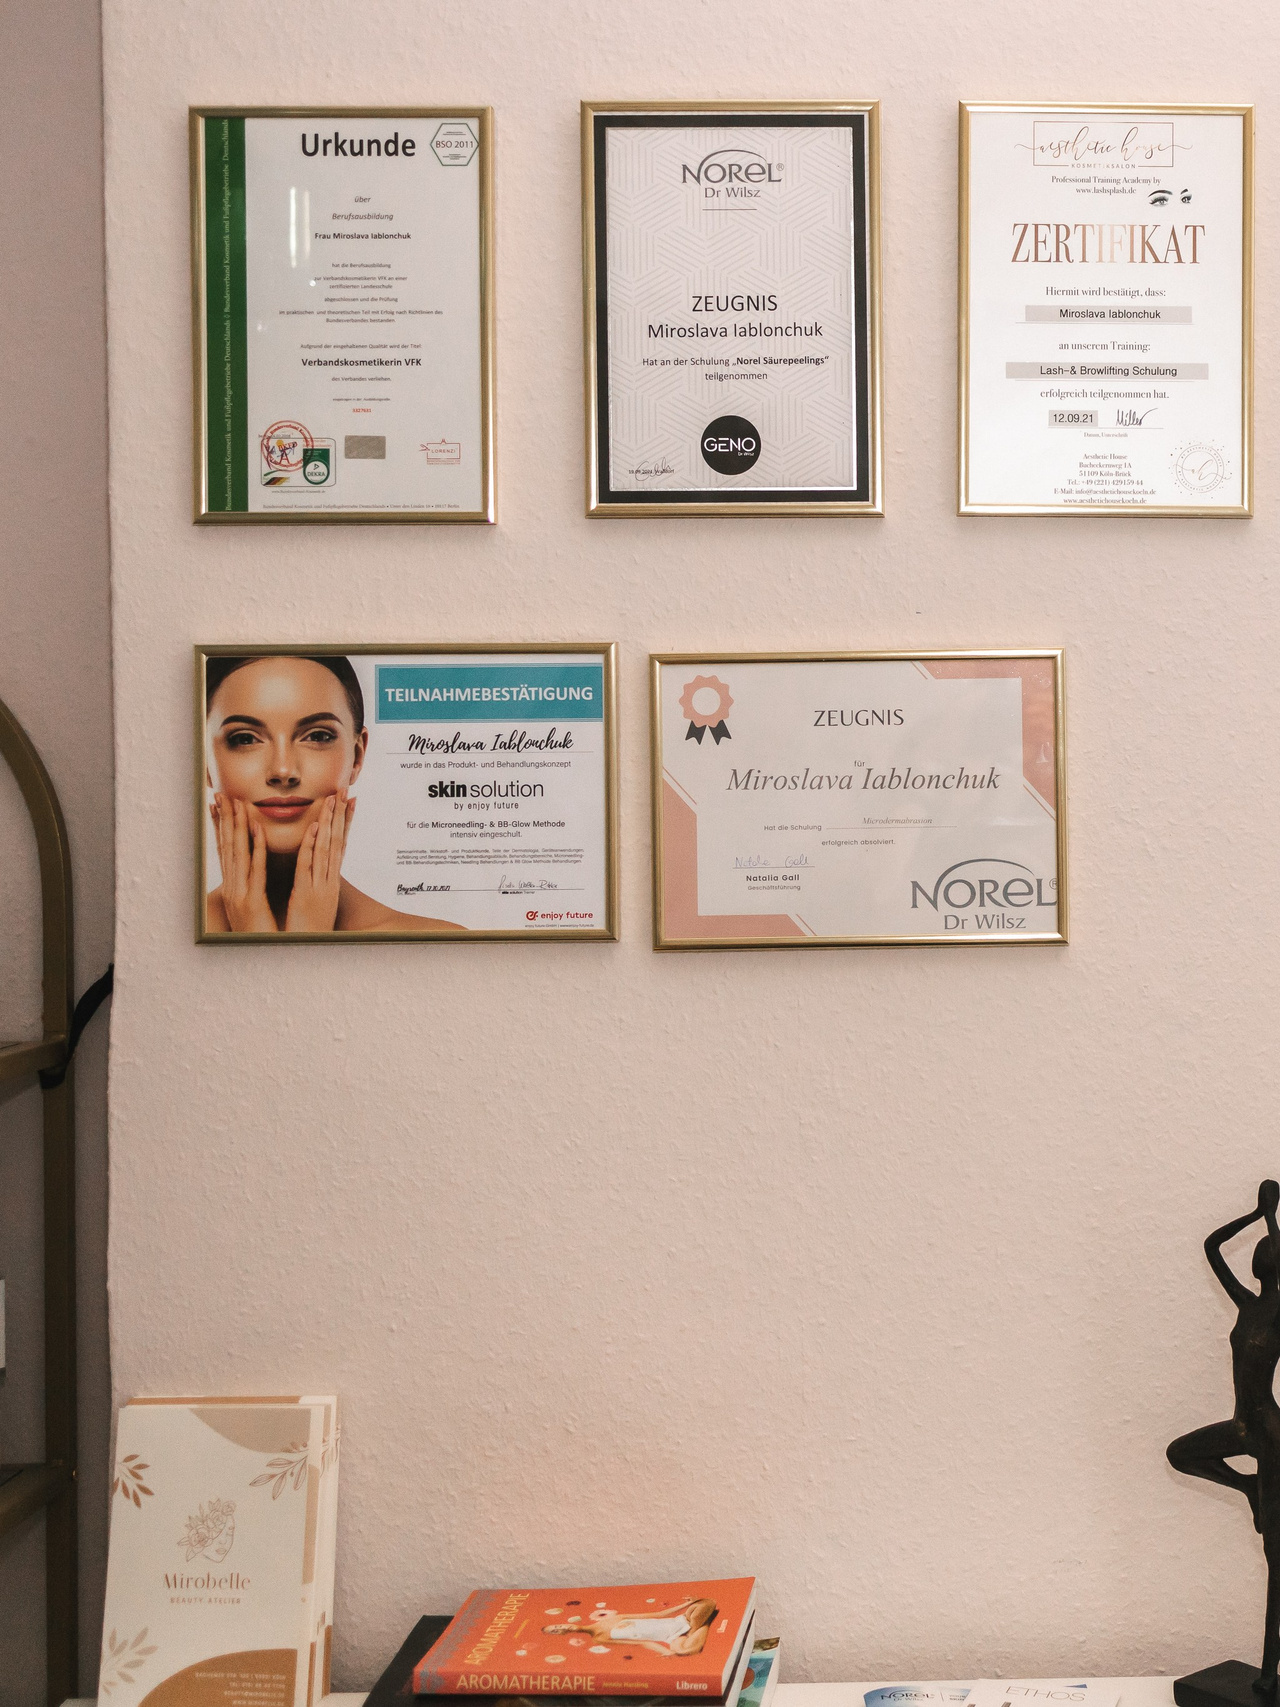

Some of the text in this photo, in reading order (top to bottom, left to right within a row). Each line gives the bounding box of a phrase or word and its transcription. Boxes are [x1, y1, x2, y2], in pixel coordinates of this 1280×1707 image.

[302, 132, 415, 156] Urkunde
[436, 140, 474, 149] BSO 2011
[1094, 176, 1121, 185] Training
[1123, 177, 1151, 185] Academy
[1153, 177, 1160, 186] by
[705, 187, 760, 198] Dr Wilsz
[1011, 223, 1205, 264] ZERTIFIKAT
[1046, 287, 1165, 298] Hiermit wird bestätigt, dass:
[692, 295, 777, 312] ZEUGNIS
[1060, 309, 1105, 318] Miroslava
[649, 323, 727, 338] Miroslava
[1110, 342, 1150, 353] Training:
[691, 358, 729, 366] Schulung
[705, 372, 767, 382] teilgenommen
[1040, 389, 1169, 400] erfolgreich teilgenommen hat.
[1054, 414, 1092, 423] 12.09.21
[704, 438, 755, 453] GENO
[385, 684, 592, 701] TEILNAHMEBESTÄTIGUNG
[814, 709, 904, 726] ZEUGNIS
[497, 761, 571, 769] Behandlungskonzept
[726, 767, 1001, 791] Miroslava Iablonchuk
[428, 780, 543, 798] skin solution
[454, 802, 463, 811] by
[480, 831, 522, 839] eingeschult.
[541, 912, 563, 920] enjoy
[944, 913, 1026, 929] Dr Wilsz
[165, 1572, 250, 1589] Mirobelle
[464, 1592, 530, 1665] AROMATHERAPIE
[457, 1673, 595, 1690] AROMATHERAPIE
[676, 1681, 707, 1690] Librero
[1005, 1686, 1086, 1702] ETHOS
